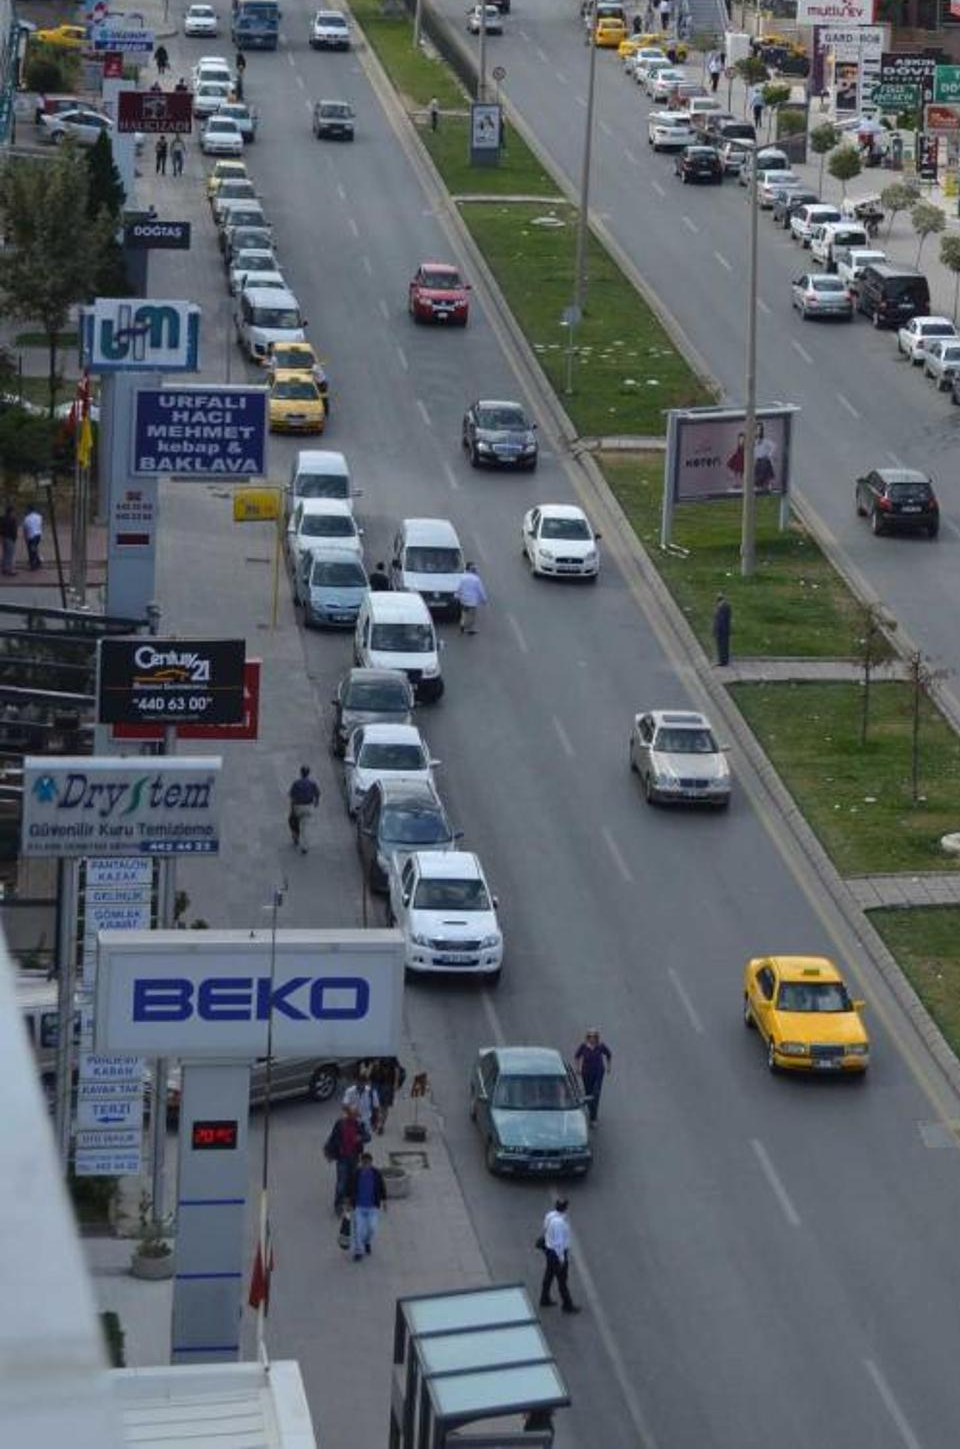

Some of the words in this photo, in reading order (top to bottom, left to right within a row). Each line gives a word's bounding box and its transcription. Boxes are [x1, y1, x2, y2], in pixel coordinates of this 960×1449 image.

[159, 395, 247, 409] URFALI
[172, 411, 233, 424] HACI
[147, 425, 255, 439] MEHMET
[157, 439, 221, 454] kebap
[228, 440, 243, 453] &
[139, 457, 259, 472] BAKLAVA
[135, 645, 199, 669] Century
[191, 659, 210, 681] 21
[99, 823, 134, 837] Kuru
[133, 976, 370, 1022] BEKO
